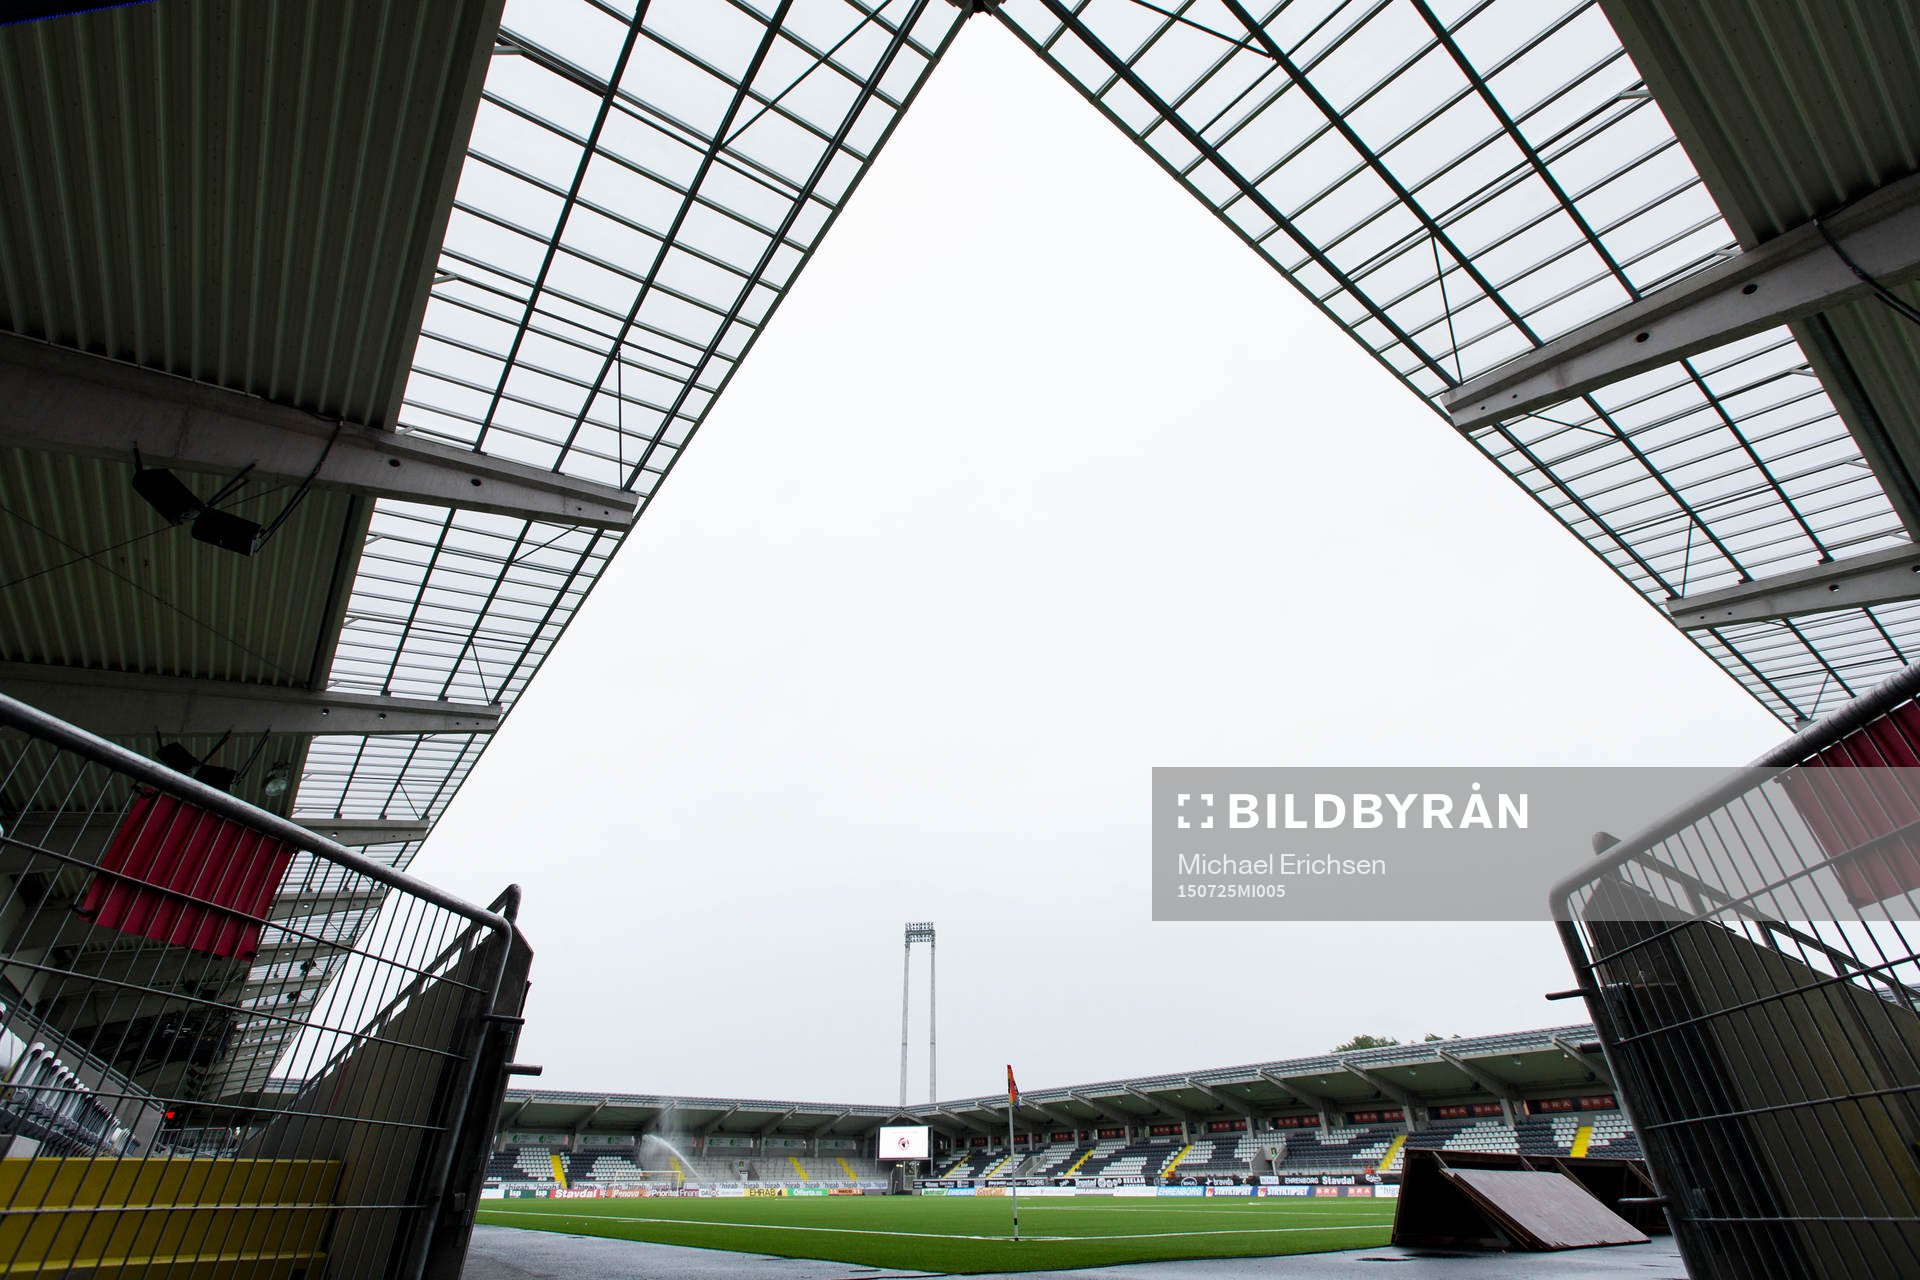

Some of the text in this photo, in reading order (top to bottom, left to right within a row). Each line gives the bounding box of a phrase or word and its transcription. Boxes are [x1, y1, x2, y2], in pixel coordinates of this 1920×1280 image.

[1322, 1175, 1355, 1185] Stavdal
[555, 1189, 597, 1198] Stavdal
[750, 1188, 775, 1196] EHRAB
